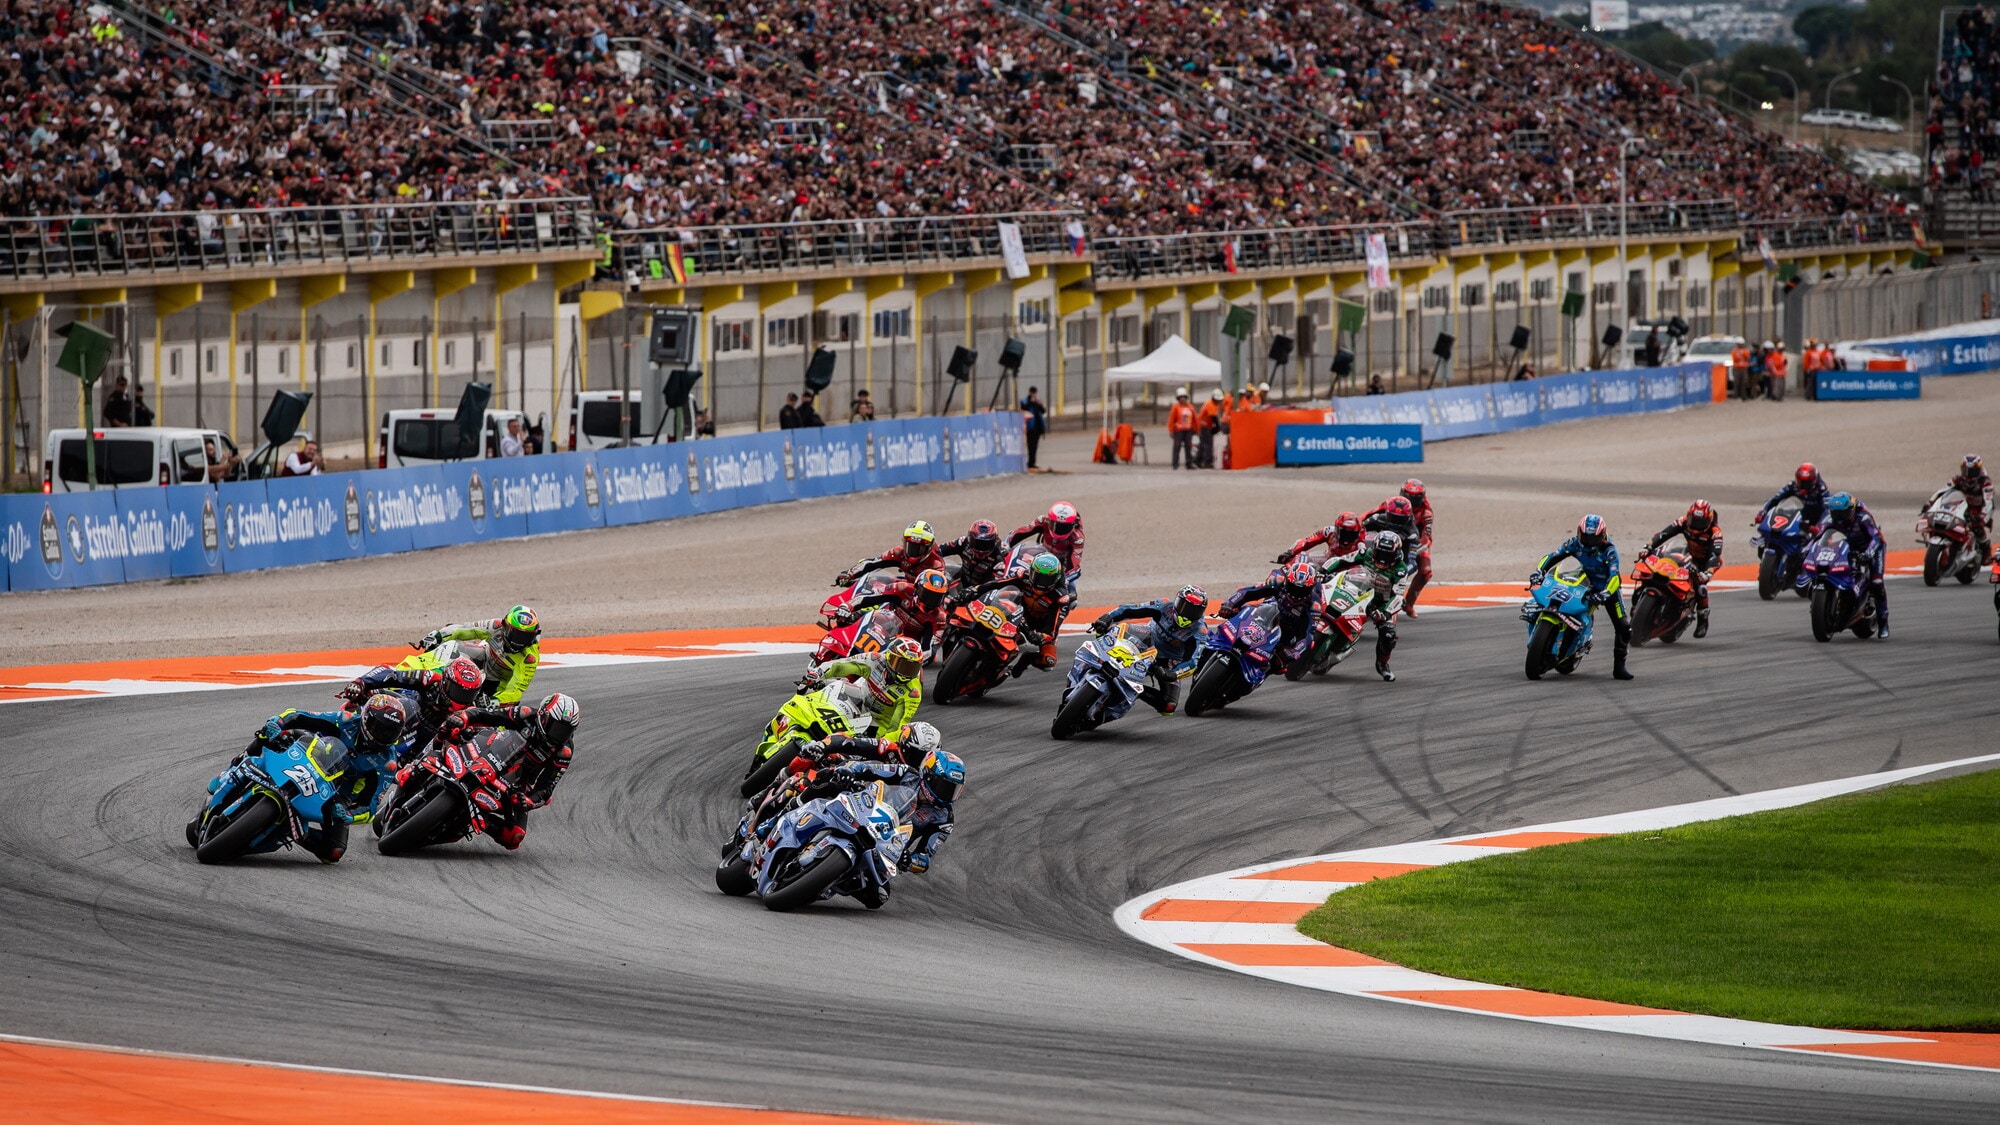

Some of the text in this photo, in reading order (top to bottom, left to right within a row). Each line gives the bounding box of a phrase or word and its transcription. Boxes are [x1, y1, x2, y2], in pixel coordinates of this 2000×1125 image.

[1297, 436, 1344, 450] Estrella
[1345, 436, 1389, 450] Galicia
[85, 514, 129, 560] Estrella
[128, 509, 165, 556] Galicia
[238, 503, 278, 547] Estrella
[277, 496, 315, 542] Galicia
[979, 609, 1003, 629] 33
[854, 633, 881, 653] 10
[282, 763, 320, 797] 25
